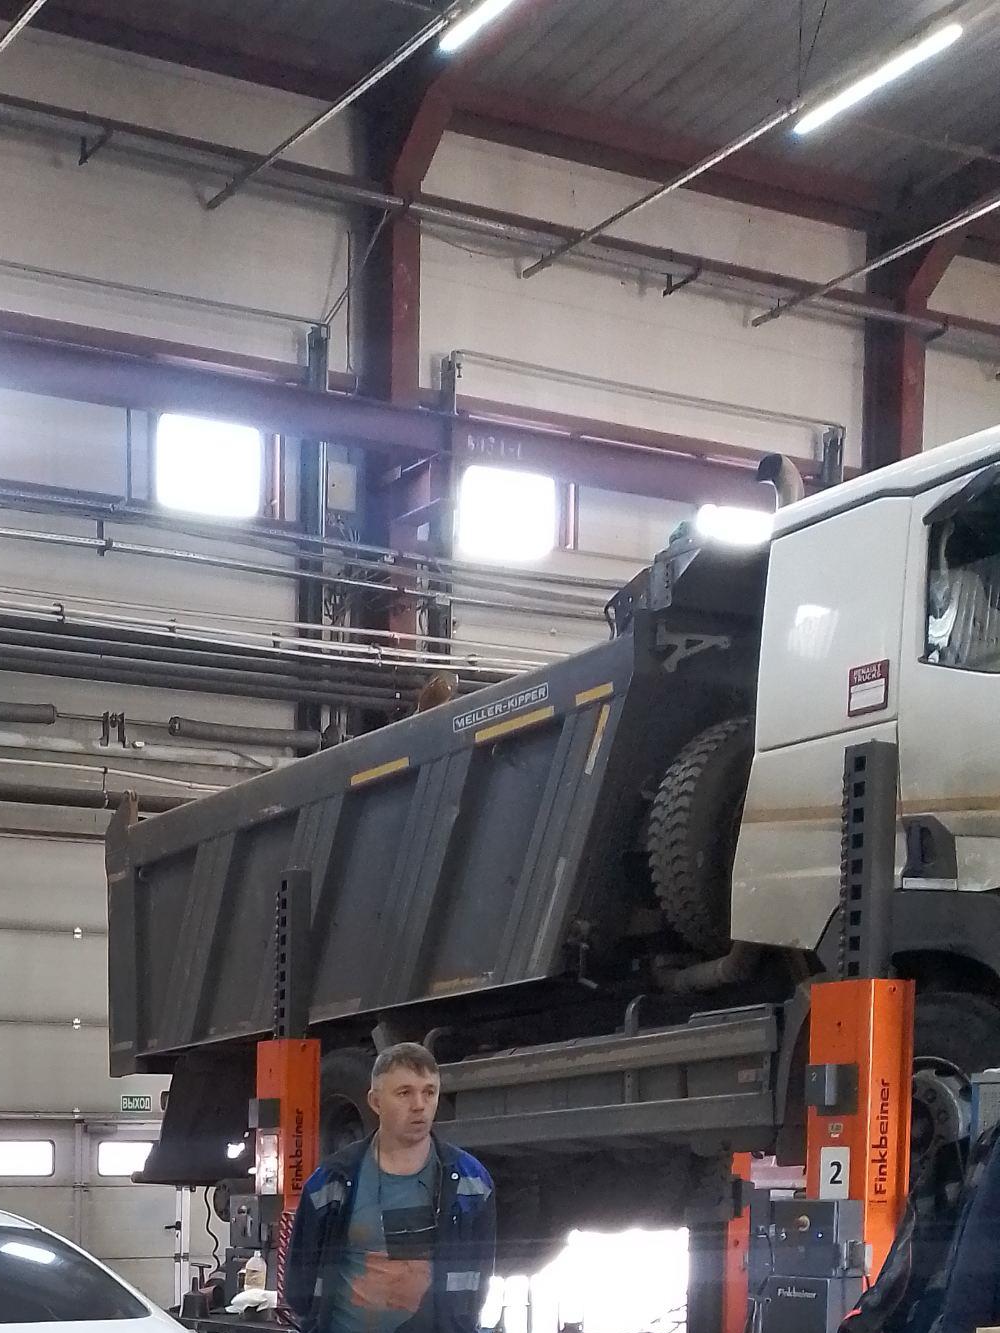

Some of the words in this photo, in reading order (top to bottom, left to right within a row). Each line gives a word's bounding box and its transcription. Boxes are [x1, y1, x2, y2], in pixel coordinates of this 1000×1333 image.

[854, 670, 882, 684] TRUCKS
[455, 686, 546, 728] MEILLER-KIPPER
[122, 1097, 150, 1110] ВЫХОД
[289, 1108, 304, 1191] Finkbeiner
[871, 1079, 890, 1195] Finkbeiner
[829, 1161, 843, 1185] 2
